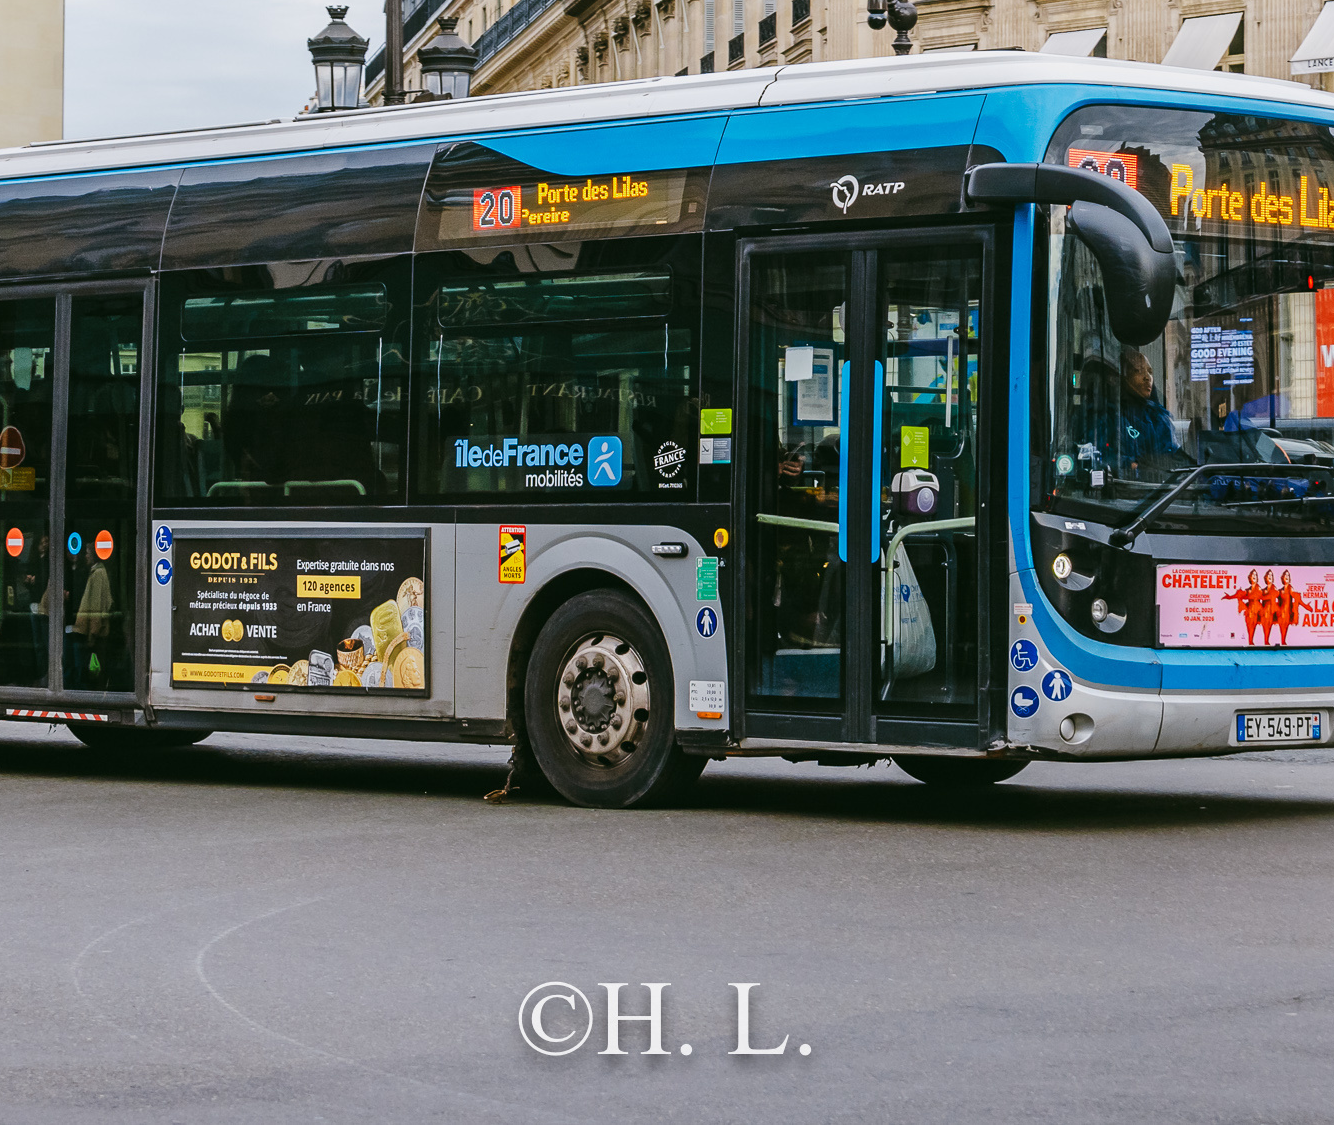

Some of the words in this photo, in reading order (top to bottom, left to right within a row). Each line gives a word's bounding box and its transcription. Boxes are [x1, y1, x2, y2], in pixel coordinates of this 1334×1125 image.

[862, 182, 905, 196] RATP
[1171, 163, 1244, 221] Porte
[1250, 182, 1294, 225] des
[480, 190, 514, 228] 20
[538, 182, 578, 205] Porte
[582, 179, 608, 201] des
[612, 176, 648, 199] Lilas
[521, 206, 570, 225] Pereire
[1190, 348, 1216, 358] GOOD
[1217, 347, 1254, 357] EVENING
[526, 468, 584, 488] mobilités
[190, 552, 240, 570] GODOT
[241, 557, 248, 570] &
[250, 552, 278, 571] FILS
[297, 560, 329, 572] Expertise
[330, 560, 359, 573] gratuite
[360, 560, 378, 571] dans
[380, 562, 394, 571] nos
[302, 580, 317, 592] 120
[319, 581, 355, 594] agences
[197, 590, 228, 600] Spécialiste
[239, 592, 260, 602] négoce
[262, 592, 269, 600] de
[190, 600, 211, 609] métaux
[212, 600, 237, 610] précieux
[238, 602, 260, 611] depuis
[262, 602, 277, 611] 1933
[297, 603, 306, 612] en
[308, 602, 331, 613] France
[1315, 600, 1329, 613] LA
[1302, 614, 1328, 627] AUX
[190, 623, 220, 636] ACHAT
[246, 625, 277, 638] VENTE
[190, 670, 244, 679] WWW.GODOTETFILS.COM
[1247, 717, 1311, 737] EY-549-PT
